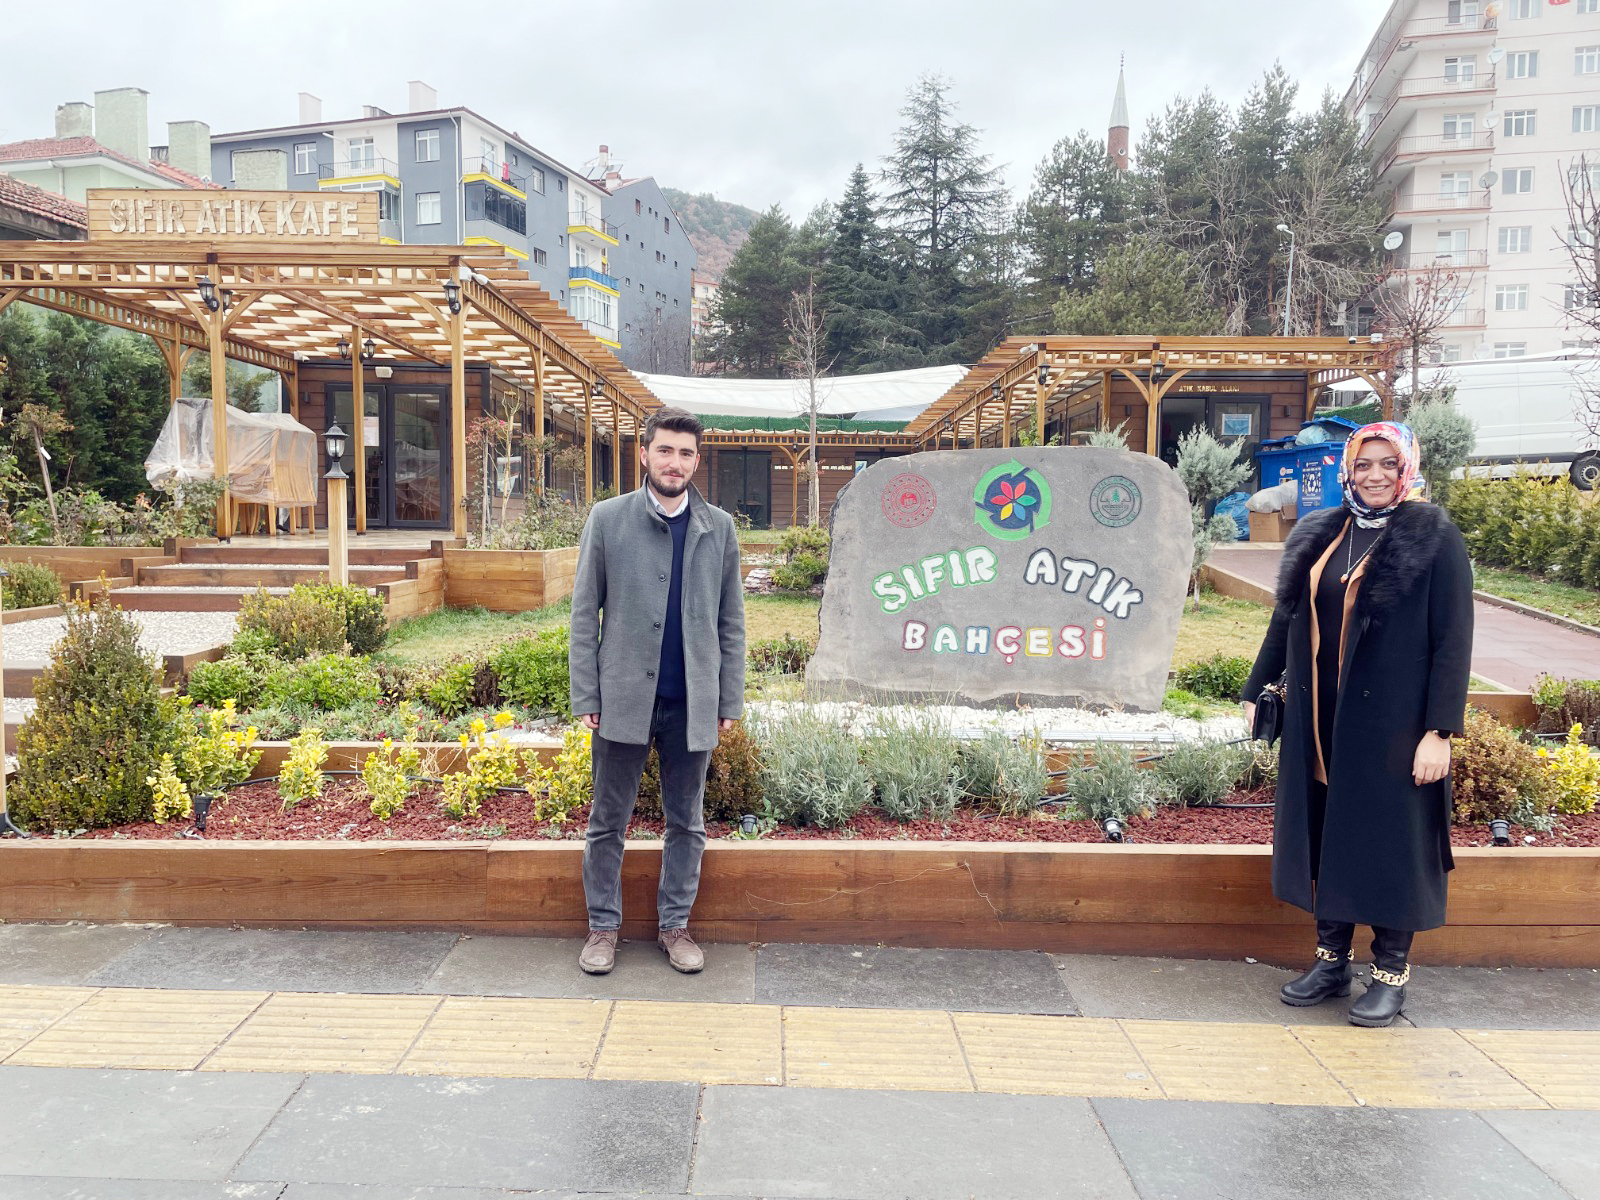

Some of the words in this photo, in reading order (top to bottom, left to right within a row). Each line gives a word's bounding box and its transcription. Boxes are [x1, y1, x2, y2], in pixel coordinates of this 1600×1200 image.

[108, 199, 186, 234] SIFIR
[196, 199, 267, 235] ATIK
[276, 200, 360, 236] KAFE
[872, 546, 998, 613] SIFIR
[1023, 548, 1143, 619] ATIK
[904, 617, 1106, 664] BAHÇESİ
